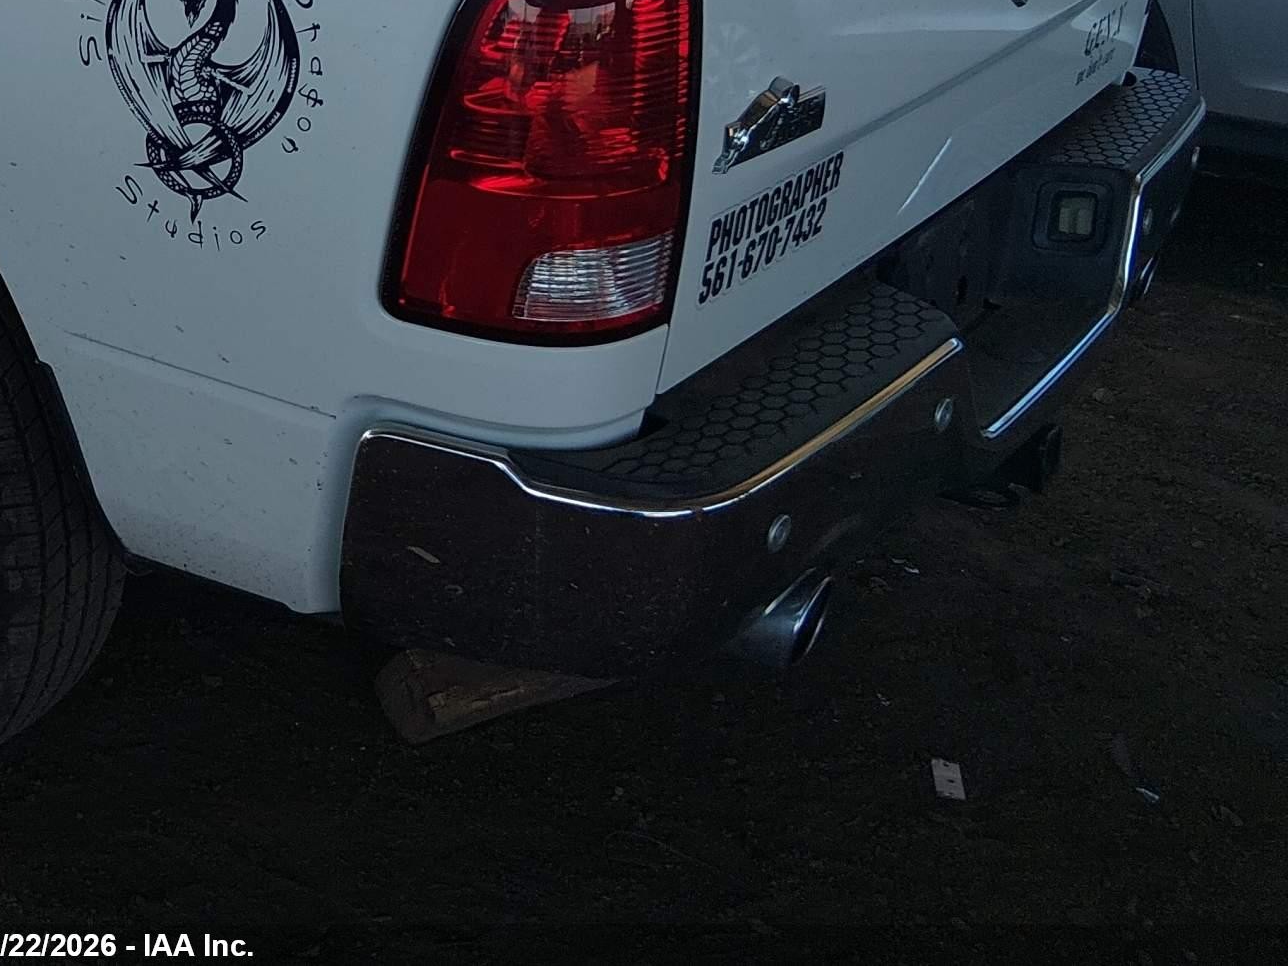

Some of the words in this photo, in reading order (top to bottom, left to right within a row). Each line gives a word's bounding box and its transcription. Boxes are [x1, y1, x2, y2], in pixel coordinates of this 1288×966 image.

[115, 175, 266, 251] Studios
[698, 197, 828, 305] 561-670-7432
[705, 150, 844, 262] PHOTOGRAPHER
